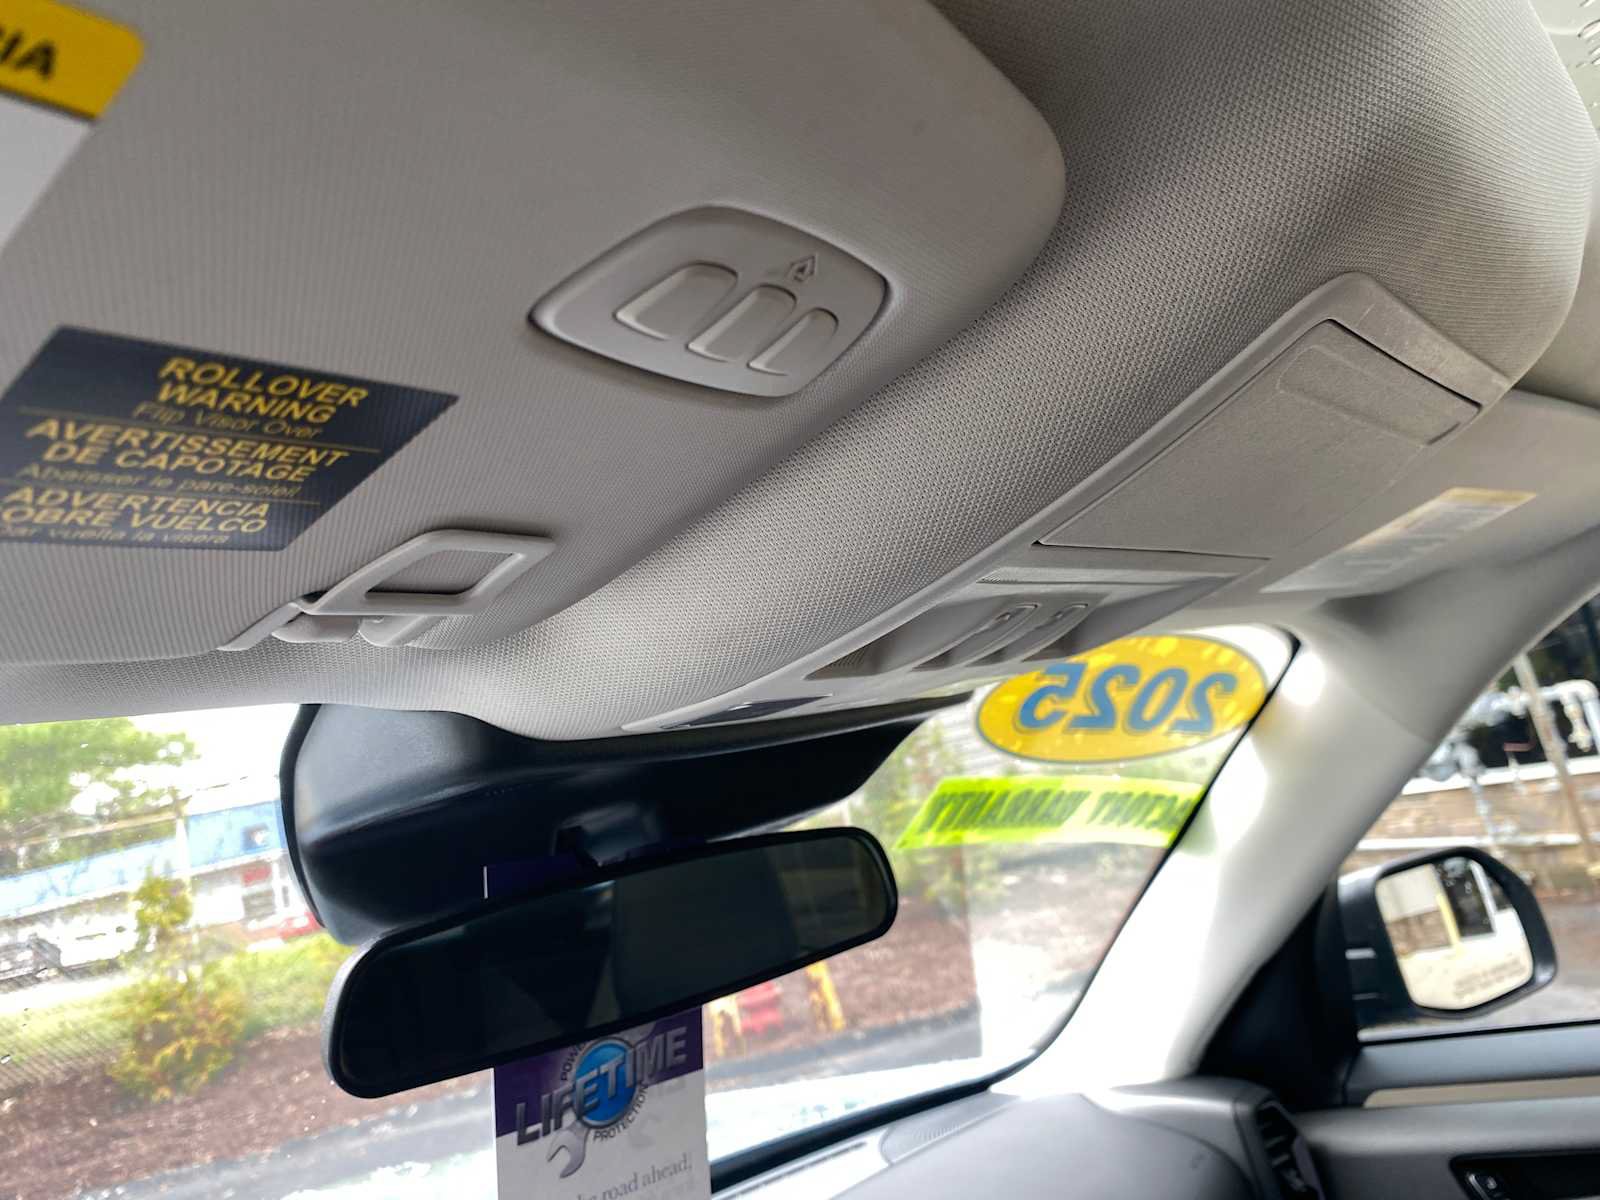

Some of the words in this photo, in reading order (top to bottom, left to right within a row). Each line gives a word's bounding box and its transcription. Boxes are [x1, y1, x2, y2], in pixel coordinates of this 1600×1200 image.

[159, 356, 369, 407] ROLLOVER
[132, 401, 186, 426] Flip
[195, 411, 259, 432] Visor
[263, 419, 324, 439] Over
[158, 383, 337, 424] WARNING
[25, 417, 350, 467] AVERTISSEMENT
[43, 440, 112, 465] DE
[115, 450, 317, 482] CAPOTAGE
[0, 485, 270, 518] ADVERTENCIA
[130, 511, 268, 533] VUELCO
[515, 1026, 688, 1146] LIFETIME
[592, 1085, 649, 1142] PROTECTION
[602, 1171, 639, 1200] road
